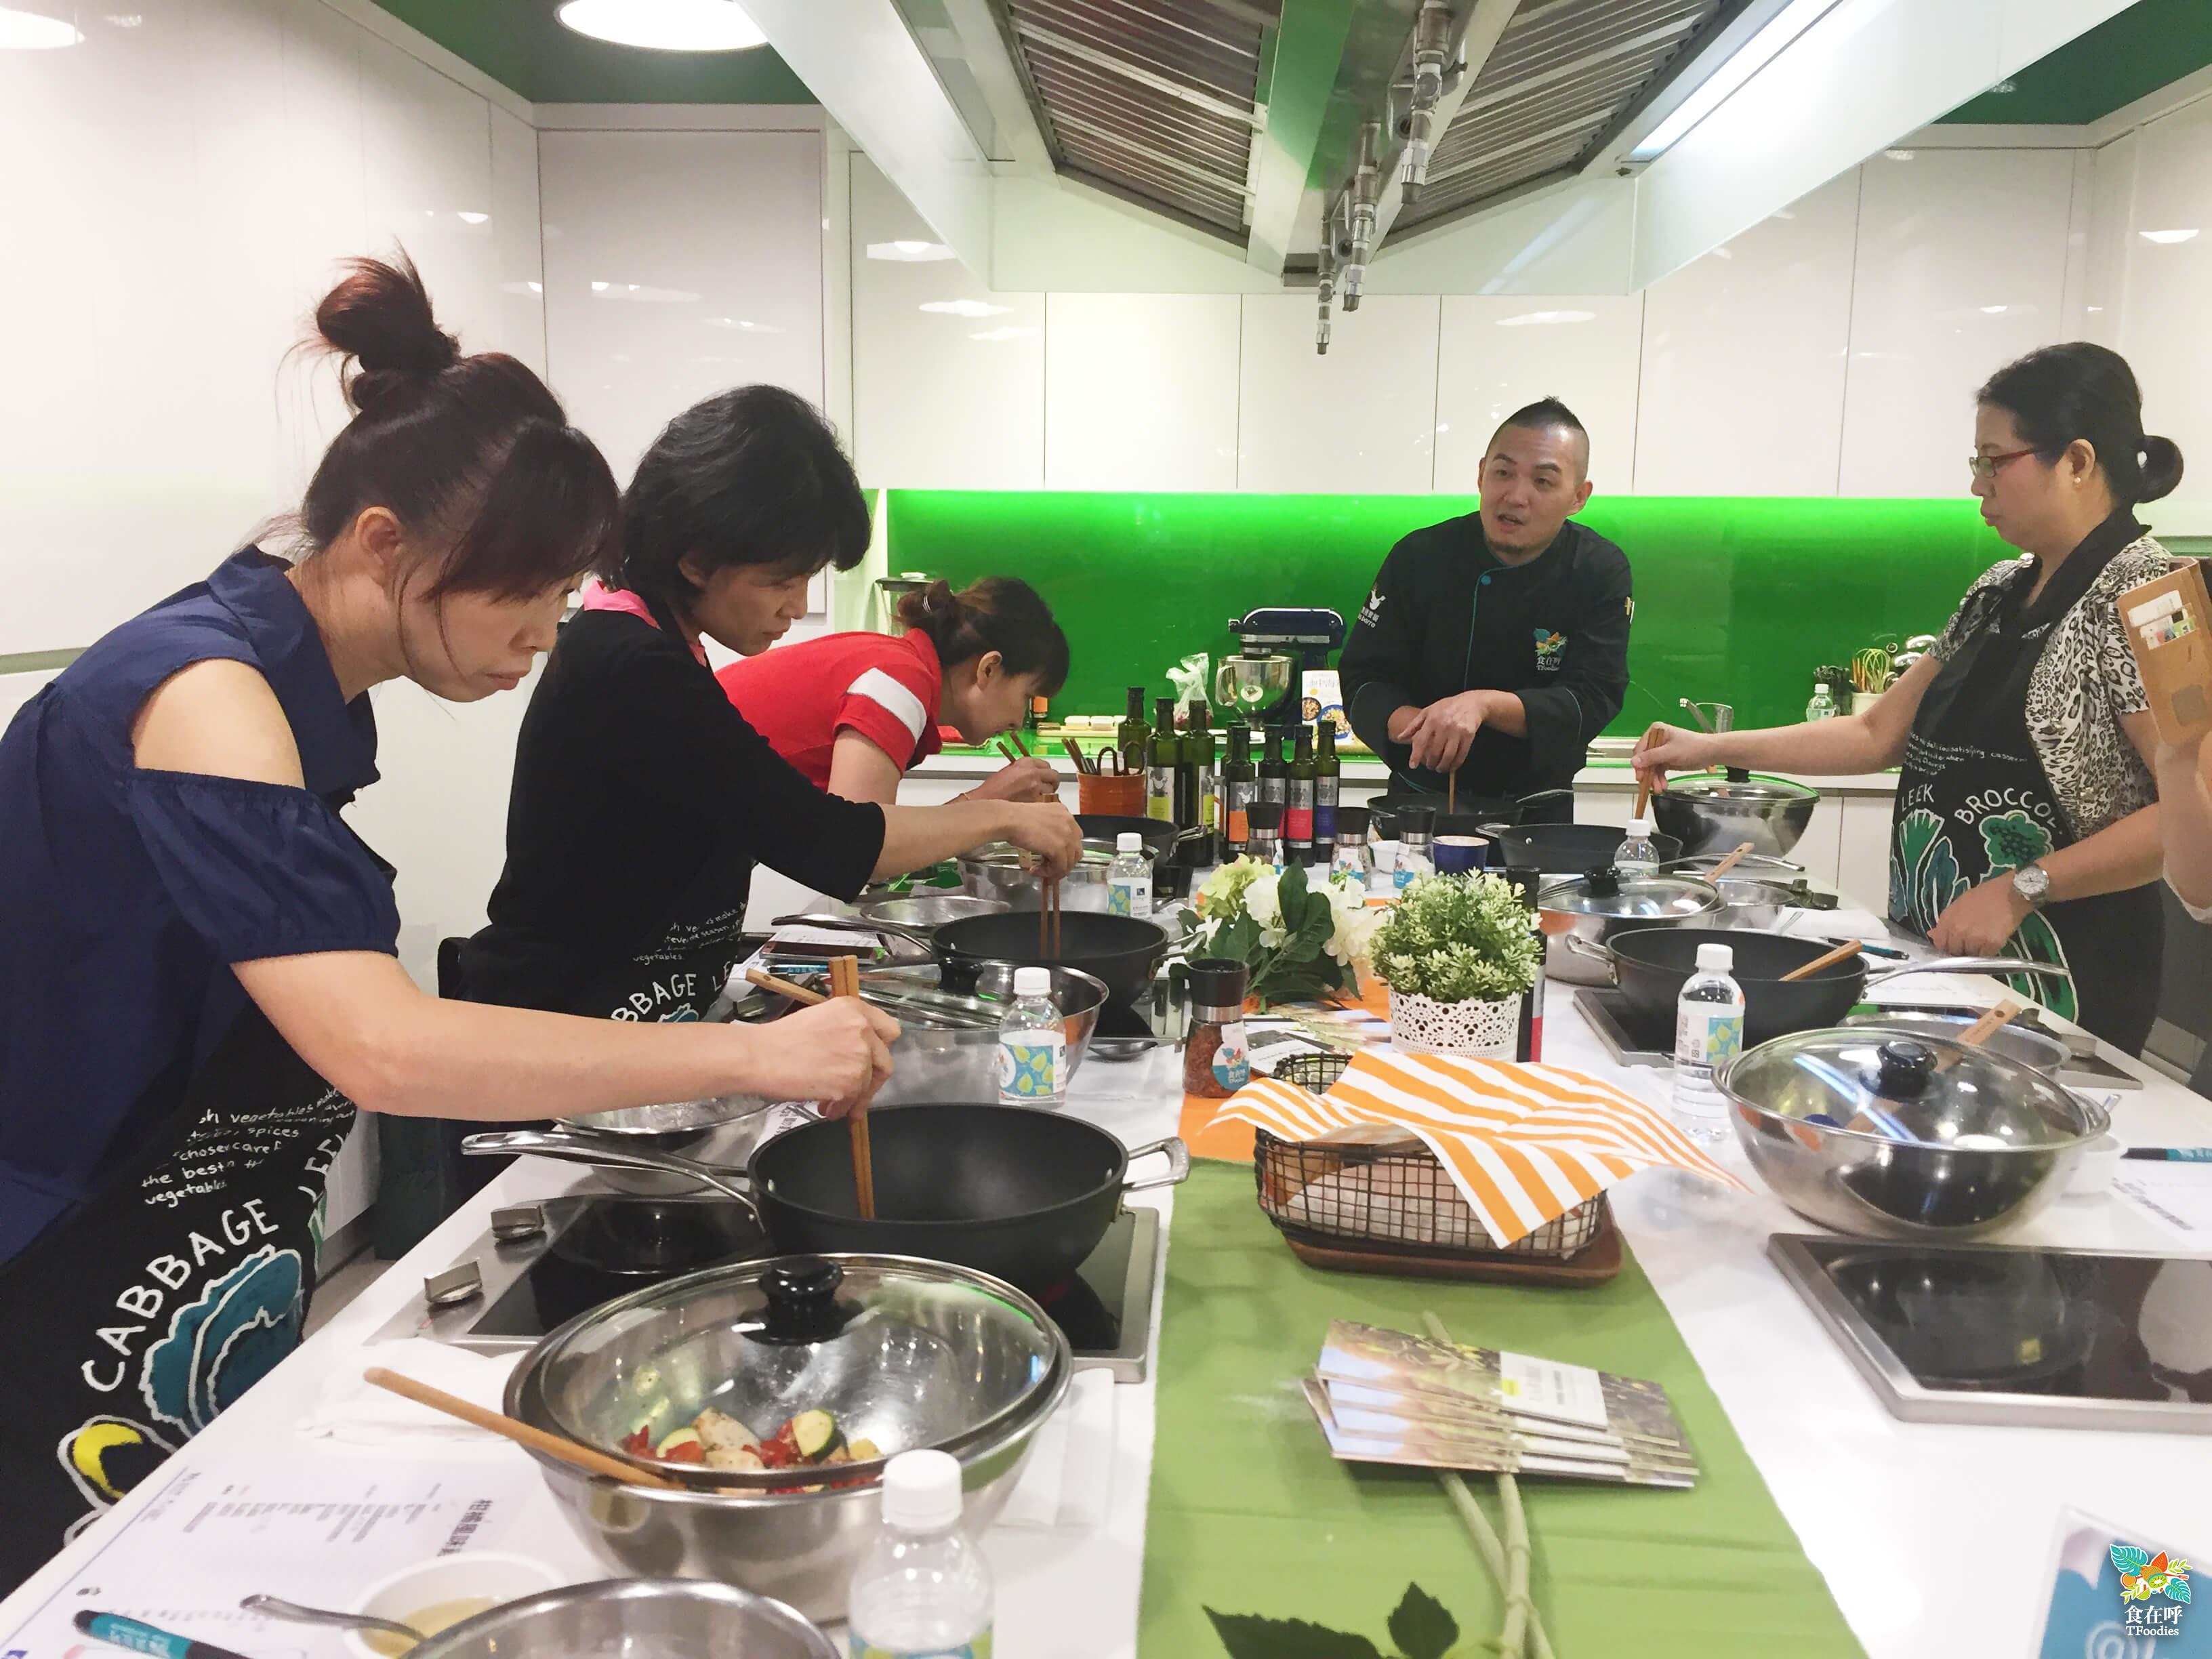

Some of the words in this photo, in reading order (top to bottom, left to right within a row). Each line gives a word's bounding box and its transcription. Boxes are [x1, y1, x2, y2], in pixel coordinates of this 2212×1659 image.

[1901, 783, 1935, 813] LEEK
[141, 1173, 173, 1189] the
[181, 1161, 225, 1180] best
[81, 1198, 280, 1393] CABBAGE
